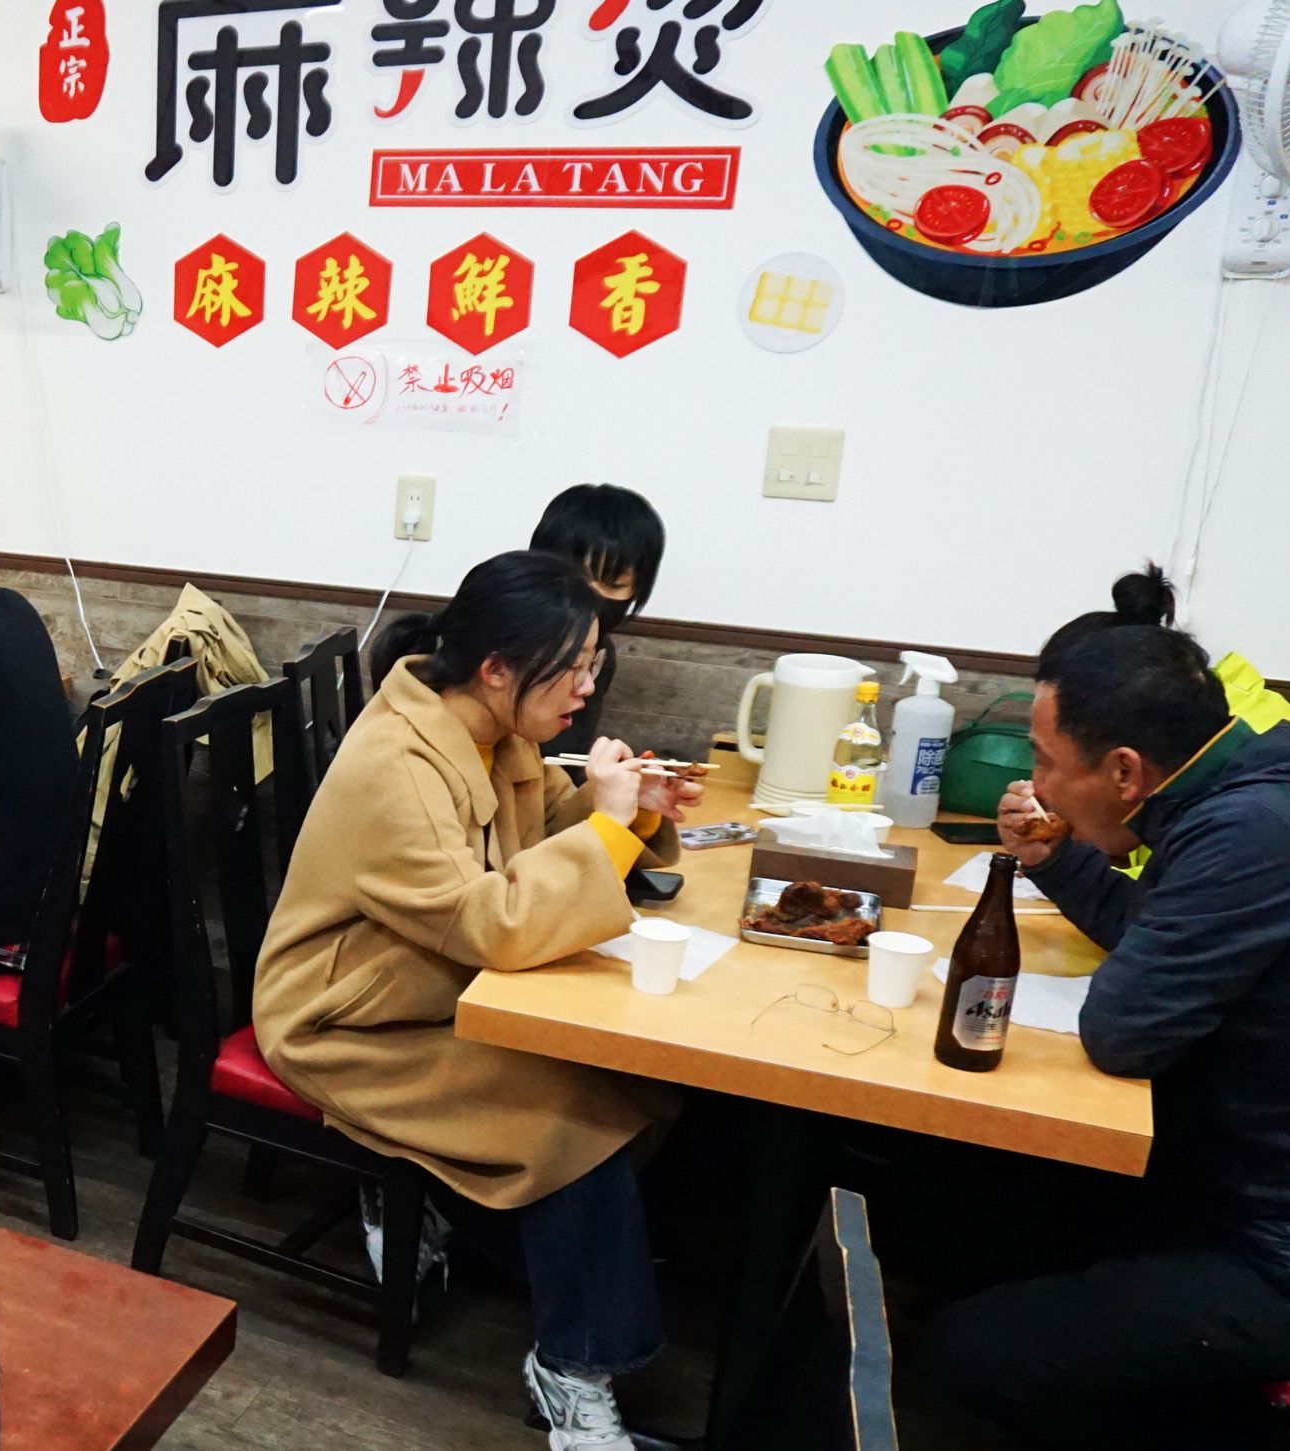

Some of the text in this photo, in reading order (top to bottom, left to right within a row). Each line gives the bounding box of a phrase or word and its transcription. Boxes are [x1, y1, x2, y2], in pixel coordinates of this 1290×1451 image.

[59, 6, 91, 98] 正宗
[397, 161, 705, 193] MA LA TANG
[186, 252, 661, 337] 麻 辣 鮮 香
[397, 362, 515, 398] 禁止吸烟
